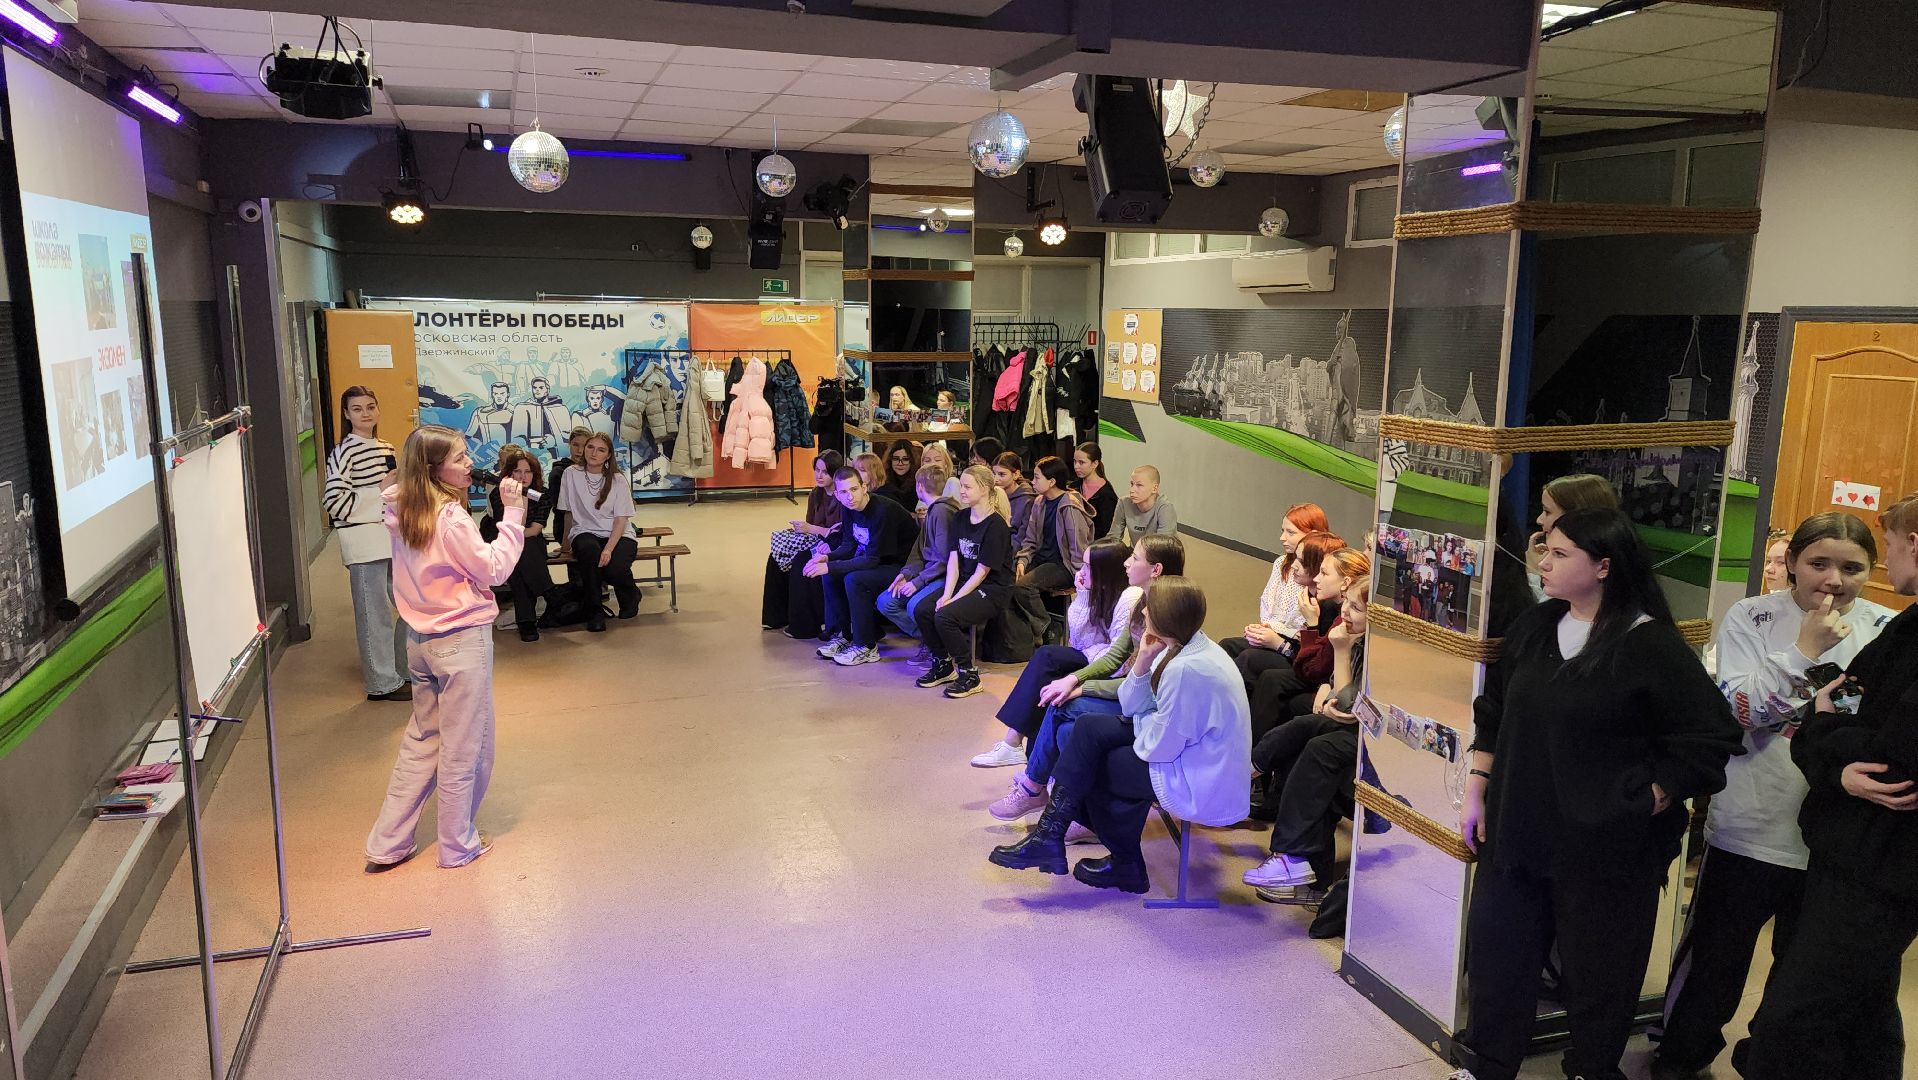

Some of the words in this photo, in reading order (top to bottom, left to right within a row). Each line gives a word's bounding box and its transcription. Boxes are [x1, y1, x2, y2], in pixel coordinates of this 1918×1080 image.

[414, 309, 525, 328] ЛОНТЁРЫ
[533, 312, 624, 330] ПОБЕДЫ
[767, 313, 818, 323] ЛИДЕР
[501, 332, 563, 343] область
[1872, 330, 1881, 342] 2
